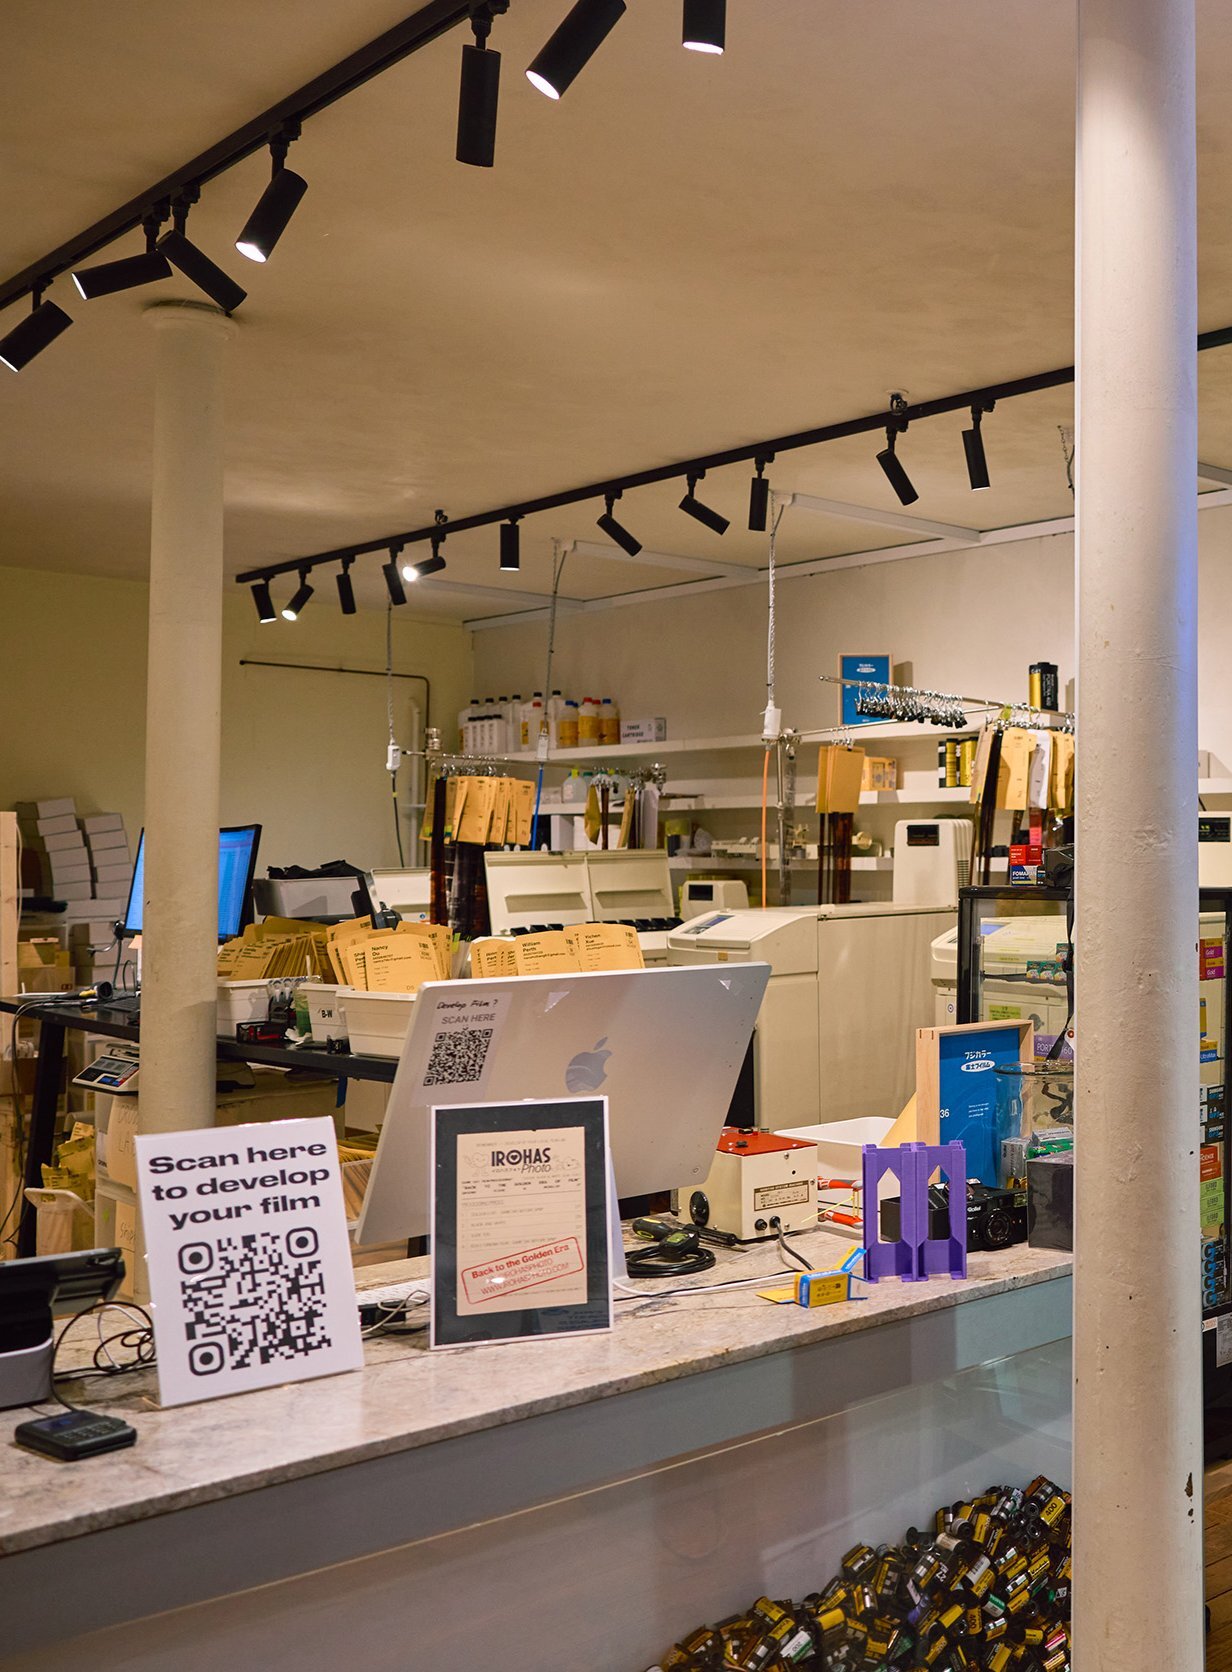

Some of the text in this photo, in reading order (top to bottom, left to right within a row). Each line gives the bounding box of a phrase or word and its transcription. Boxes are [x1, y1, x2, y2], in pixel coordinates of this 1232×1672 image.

[321, 1009, 333, 1018] B-W
[441, 1013, 496, 1025] SCAN HERE
[939, 1108, 950, 1119] 36
[148, 1143, 327, 1174] Scan here
[491, 1147, 551, 1167] IROHAS
[520, 1163, 552, 1174] Photo
[151, 1168, 330, 1201] to develop
[168, 1195, 321, 1231] your film
[471, 1266, 495, 1279] Back
[495, 1262, 505, 1272] to
[506, 1258, 521, 1268] the
[521, 1249, 553, 1263] Golden
[554, 1244, 570, 1254] Era
